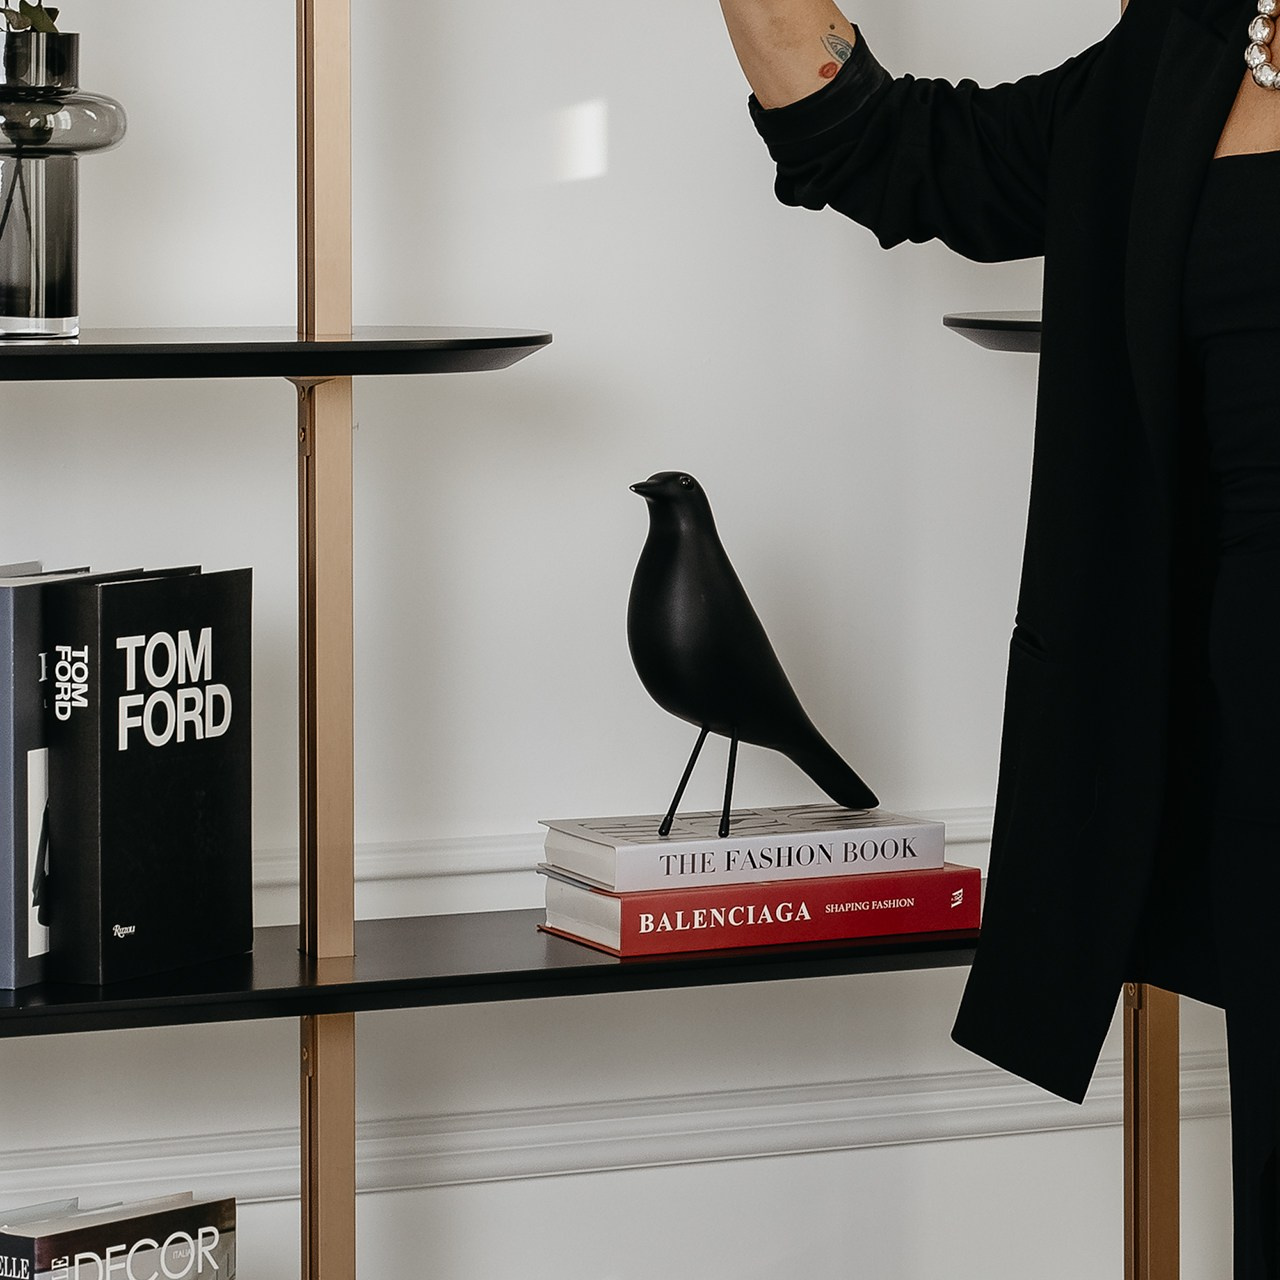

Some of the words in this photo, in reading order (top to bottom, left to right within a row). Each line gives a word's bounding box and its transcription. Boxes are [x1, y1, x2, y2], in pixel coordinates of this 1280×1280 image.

[55, 645, 72, 721] FORD
[71, 645, 89, 708] TOM
[116, 626, 212, 692] TOM
[118, 683, 233, 752] FORD
[659, 851, 716, 876] THE
[842, 836, 918, 865] BOOK
[638, 901, 812, 935] BALENCIAGA
[825, 901, 870, 914] SHAPING
[871, 898, 915, 910] FASHION
